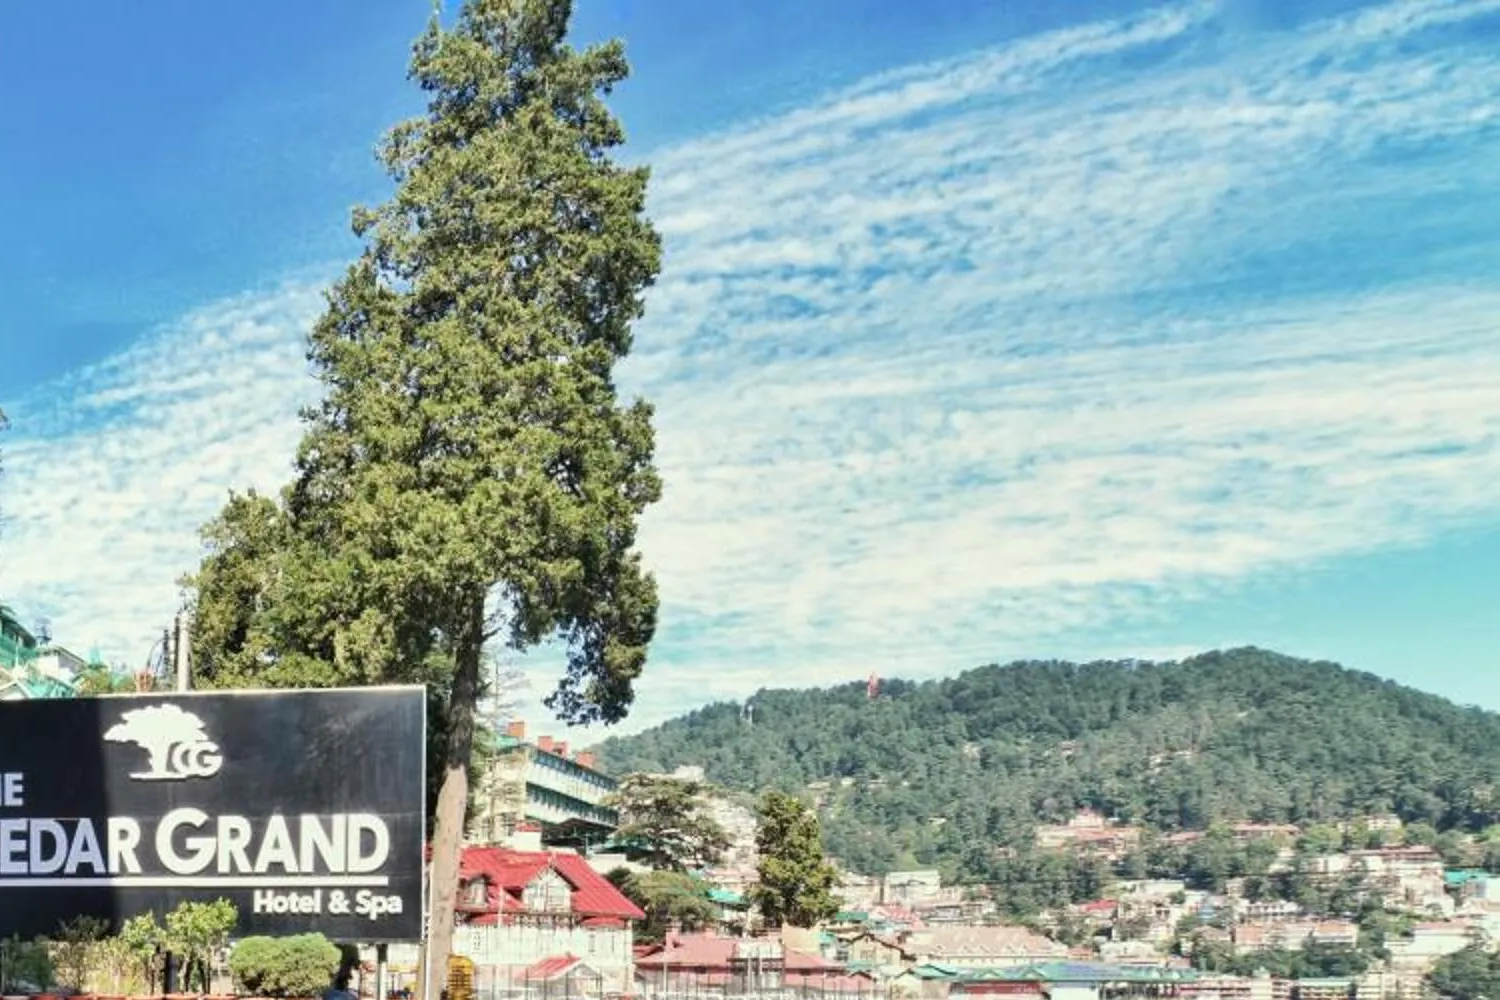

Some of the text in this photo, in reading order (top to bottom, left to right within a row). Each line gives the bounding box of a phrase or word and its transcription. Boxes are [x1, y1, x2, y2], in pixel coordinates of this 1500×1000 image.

[155, 807, 391, 875] GRAND
[253, 887, 404, 921] Hotel & Spa
